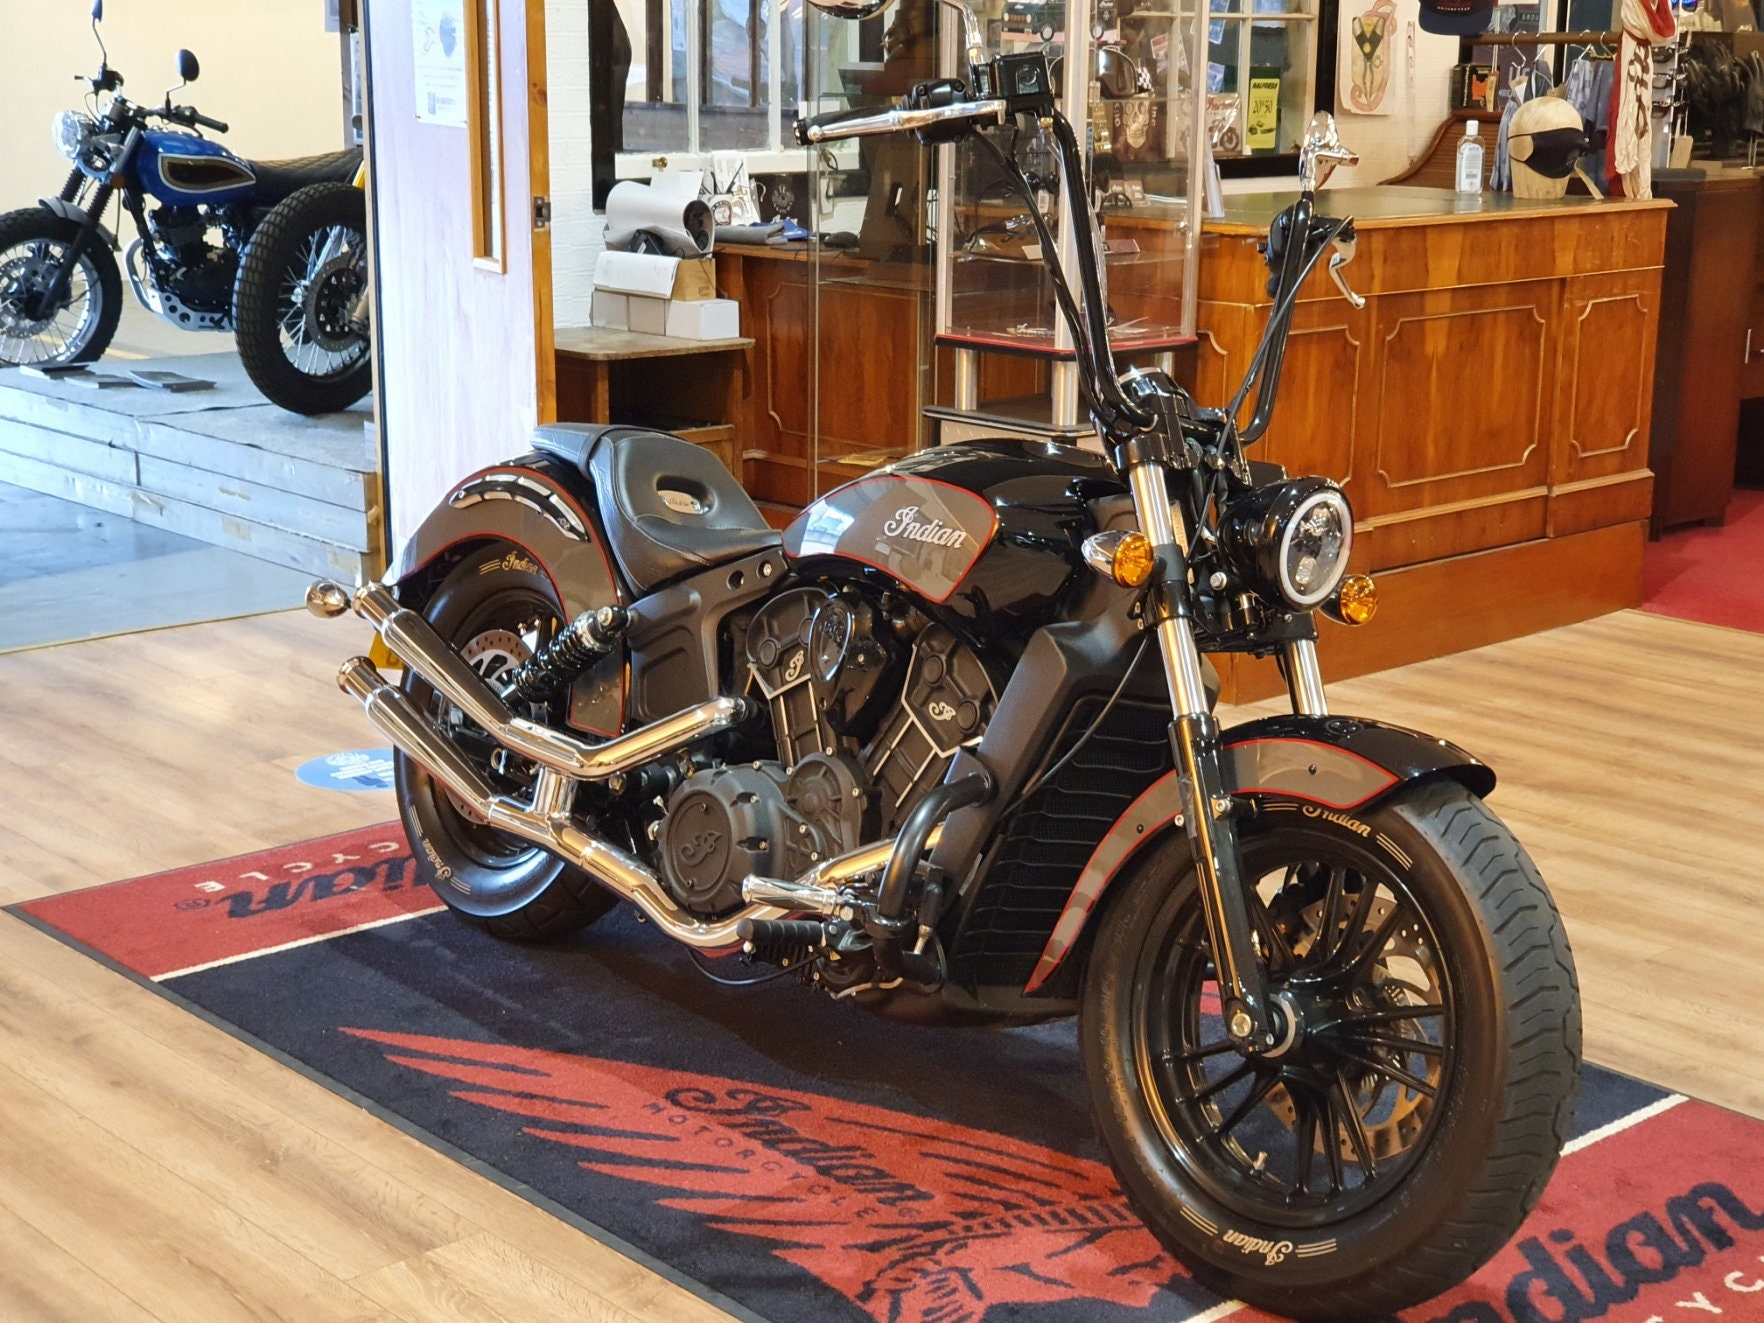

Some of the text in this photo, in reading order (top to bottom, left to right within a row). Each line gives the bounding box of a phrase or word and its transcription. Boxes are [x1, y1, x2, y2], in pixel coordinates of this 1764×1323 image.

[884, 505, 967, 549] Indian
[502, 550, 538, 576] Indian
[422, 838, 452, 881] Indian
[216, 855, 429, 919] ian
[664, 1086, 936, 1207] Indian
[1222, 1228, 1294, 1267] Indian
[1422, 1182, 1764, 1323] dian
